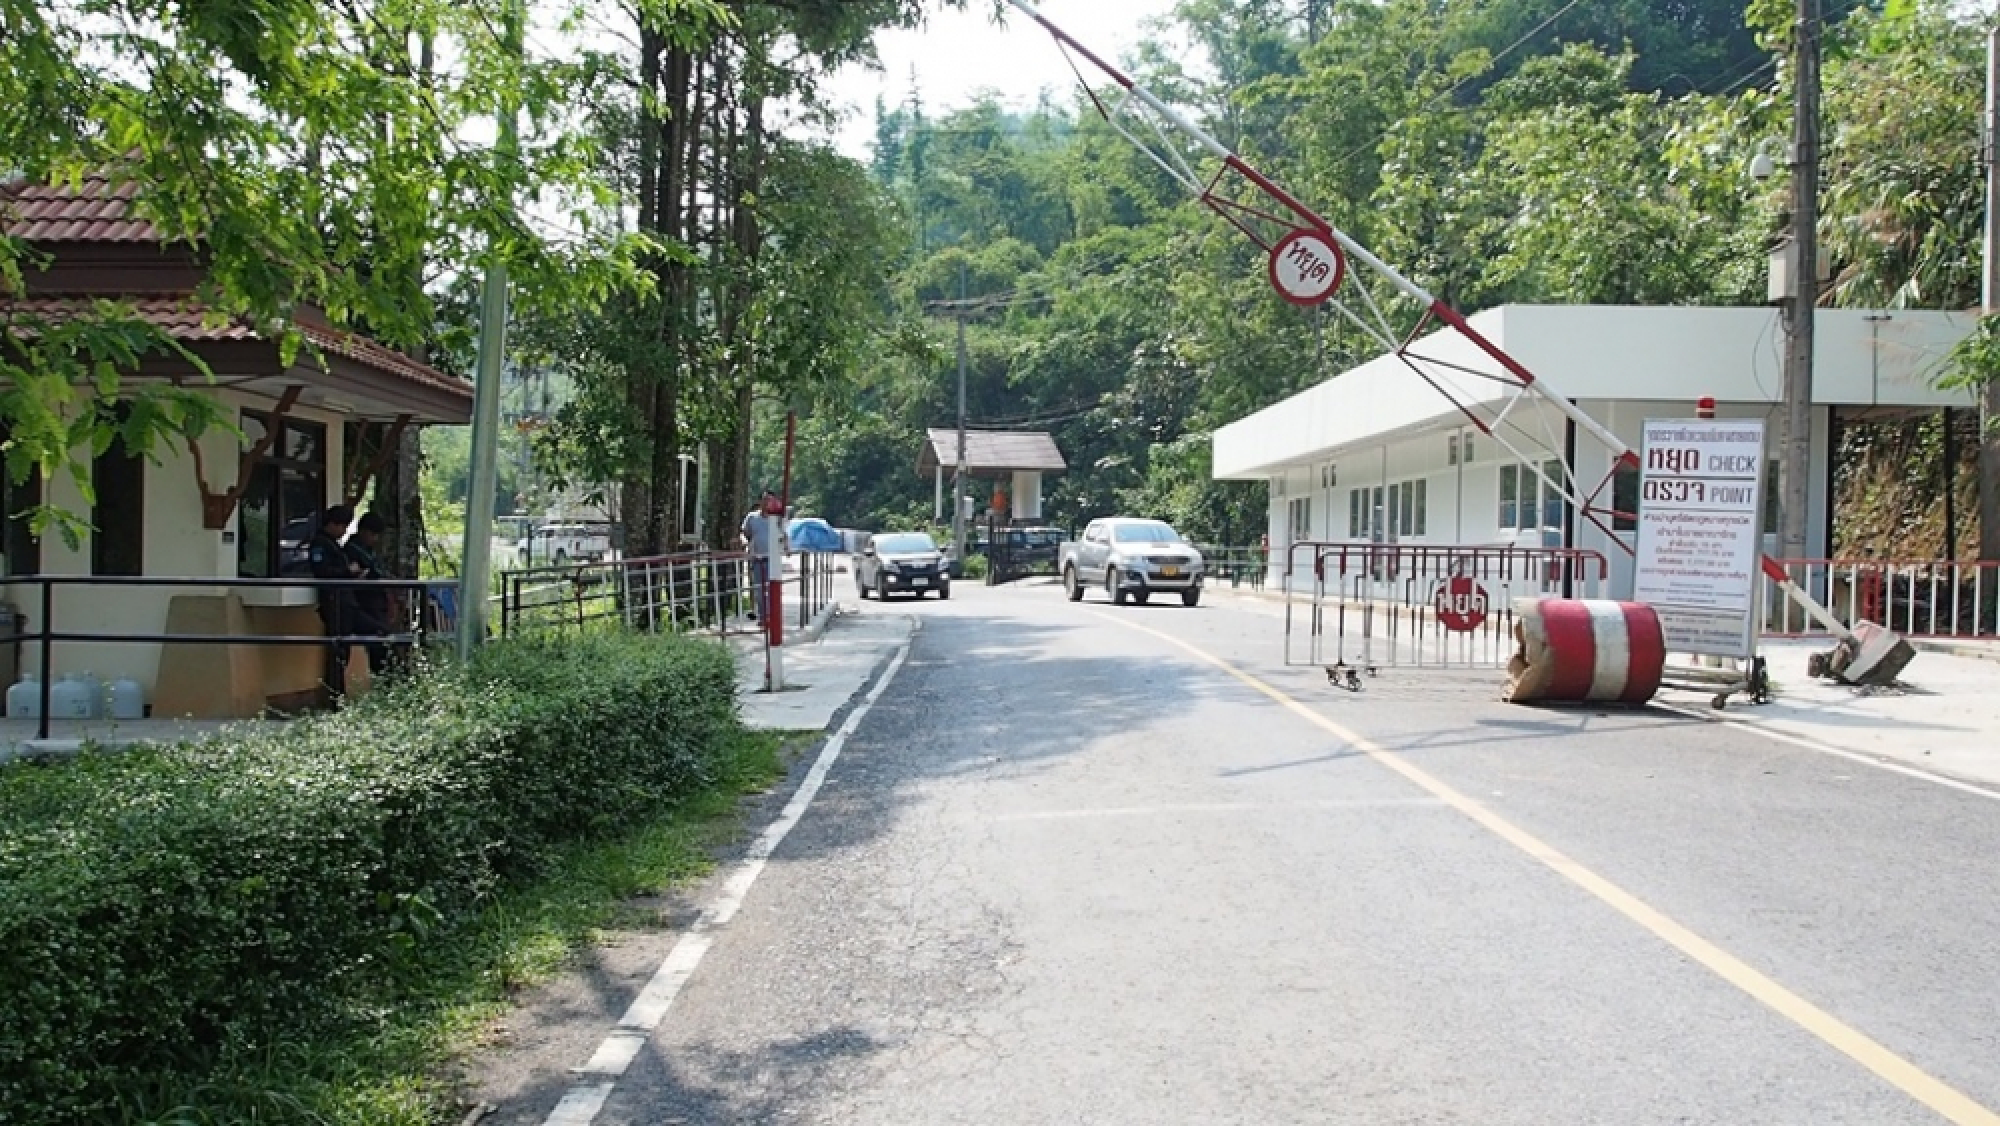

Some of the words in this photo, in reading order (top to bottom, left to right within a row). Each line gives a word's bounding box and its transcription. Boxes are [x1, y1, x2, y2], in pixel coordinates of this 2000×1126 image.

[1286, 241, 1330, 284] หยุด
[1648, 448, 1699, 474] หยุด
[1709, 456, 1756, 472] CHECK
[1644, 481, 1705, 502] ตรวจ
[1710, 486, 1753, 503] POINT
